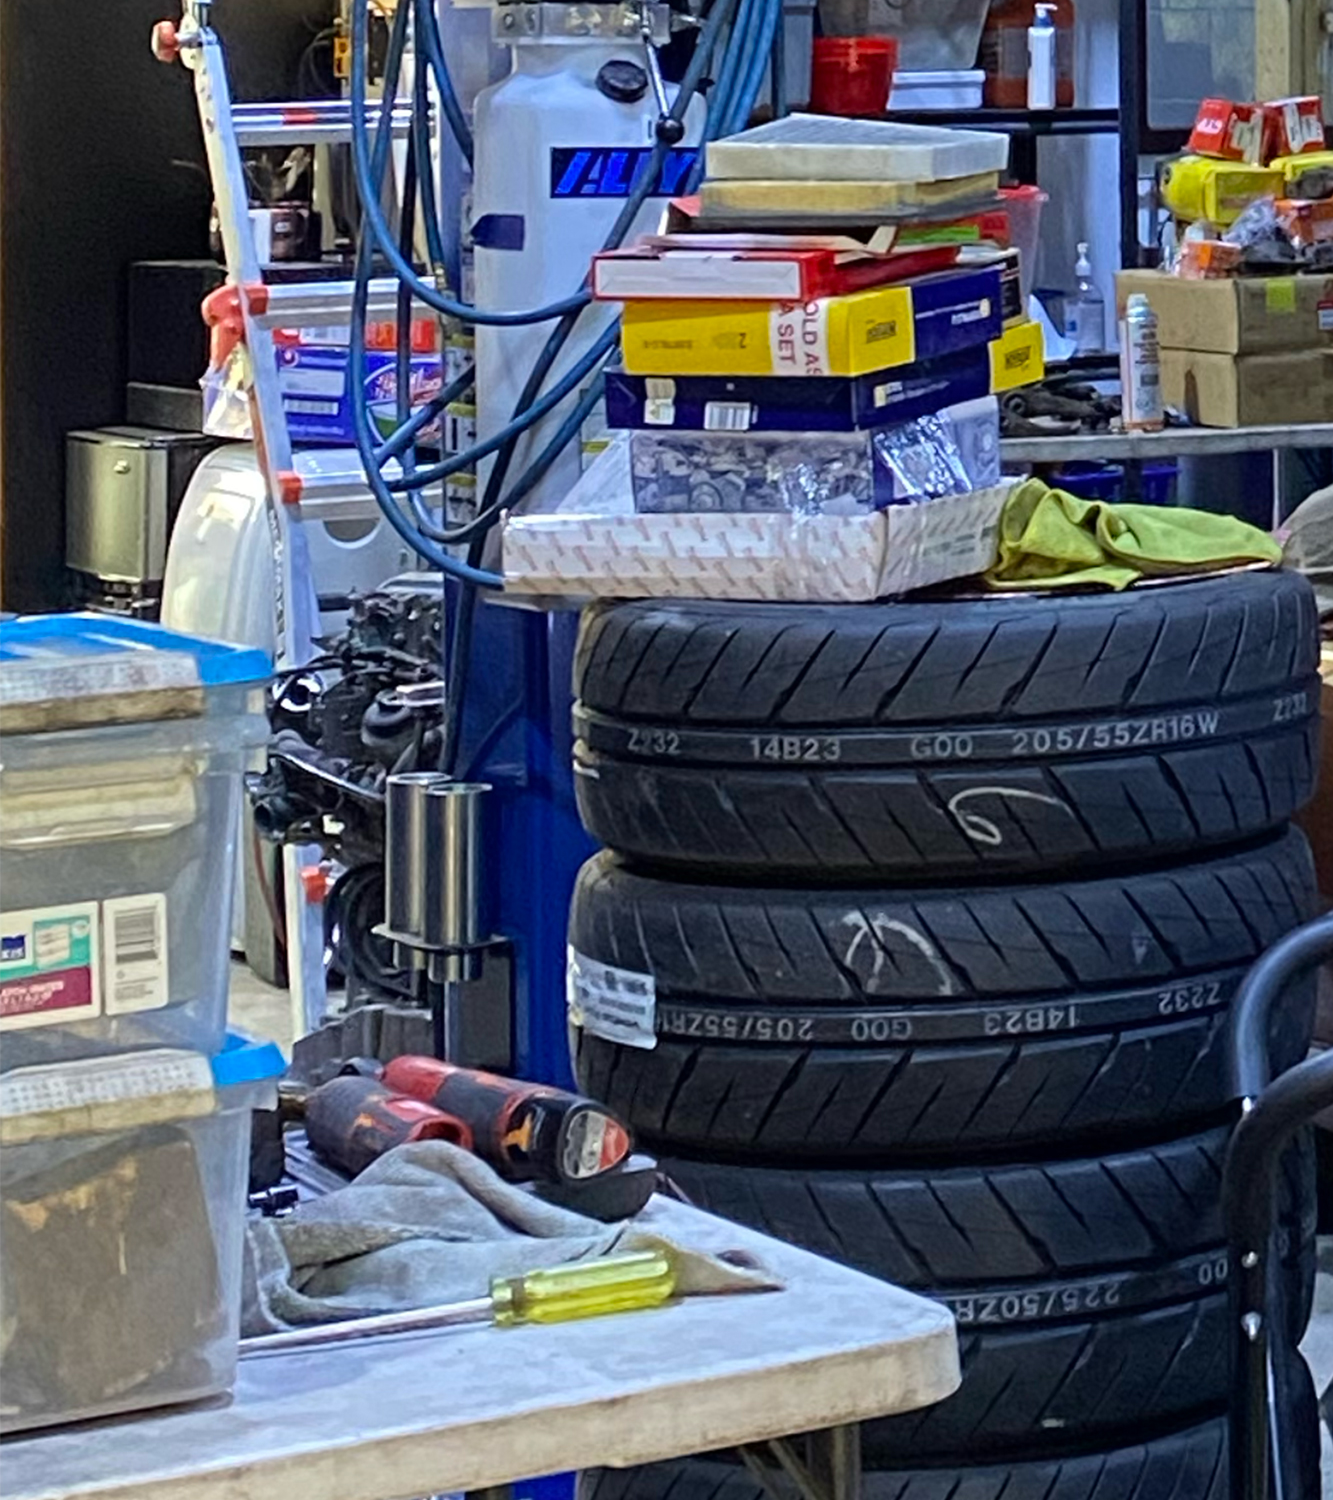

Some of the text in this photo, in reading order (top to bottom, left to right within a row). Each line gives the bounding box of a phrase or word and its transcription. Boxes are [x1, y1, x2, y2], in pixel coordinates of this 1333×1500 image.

[777, 323, 796, 366] SET
[627, 727, 681, 755] Z232
[750, 735, 842, 761] 14B23
[656, 1011, 816, 1041] 205/55ZR1
[984, 1005, 1081, 1036] 14B23
